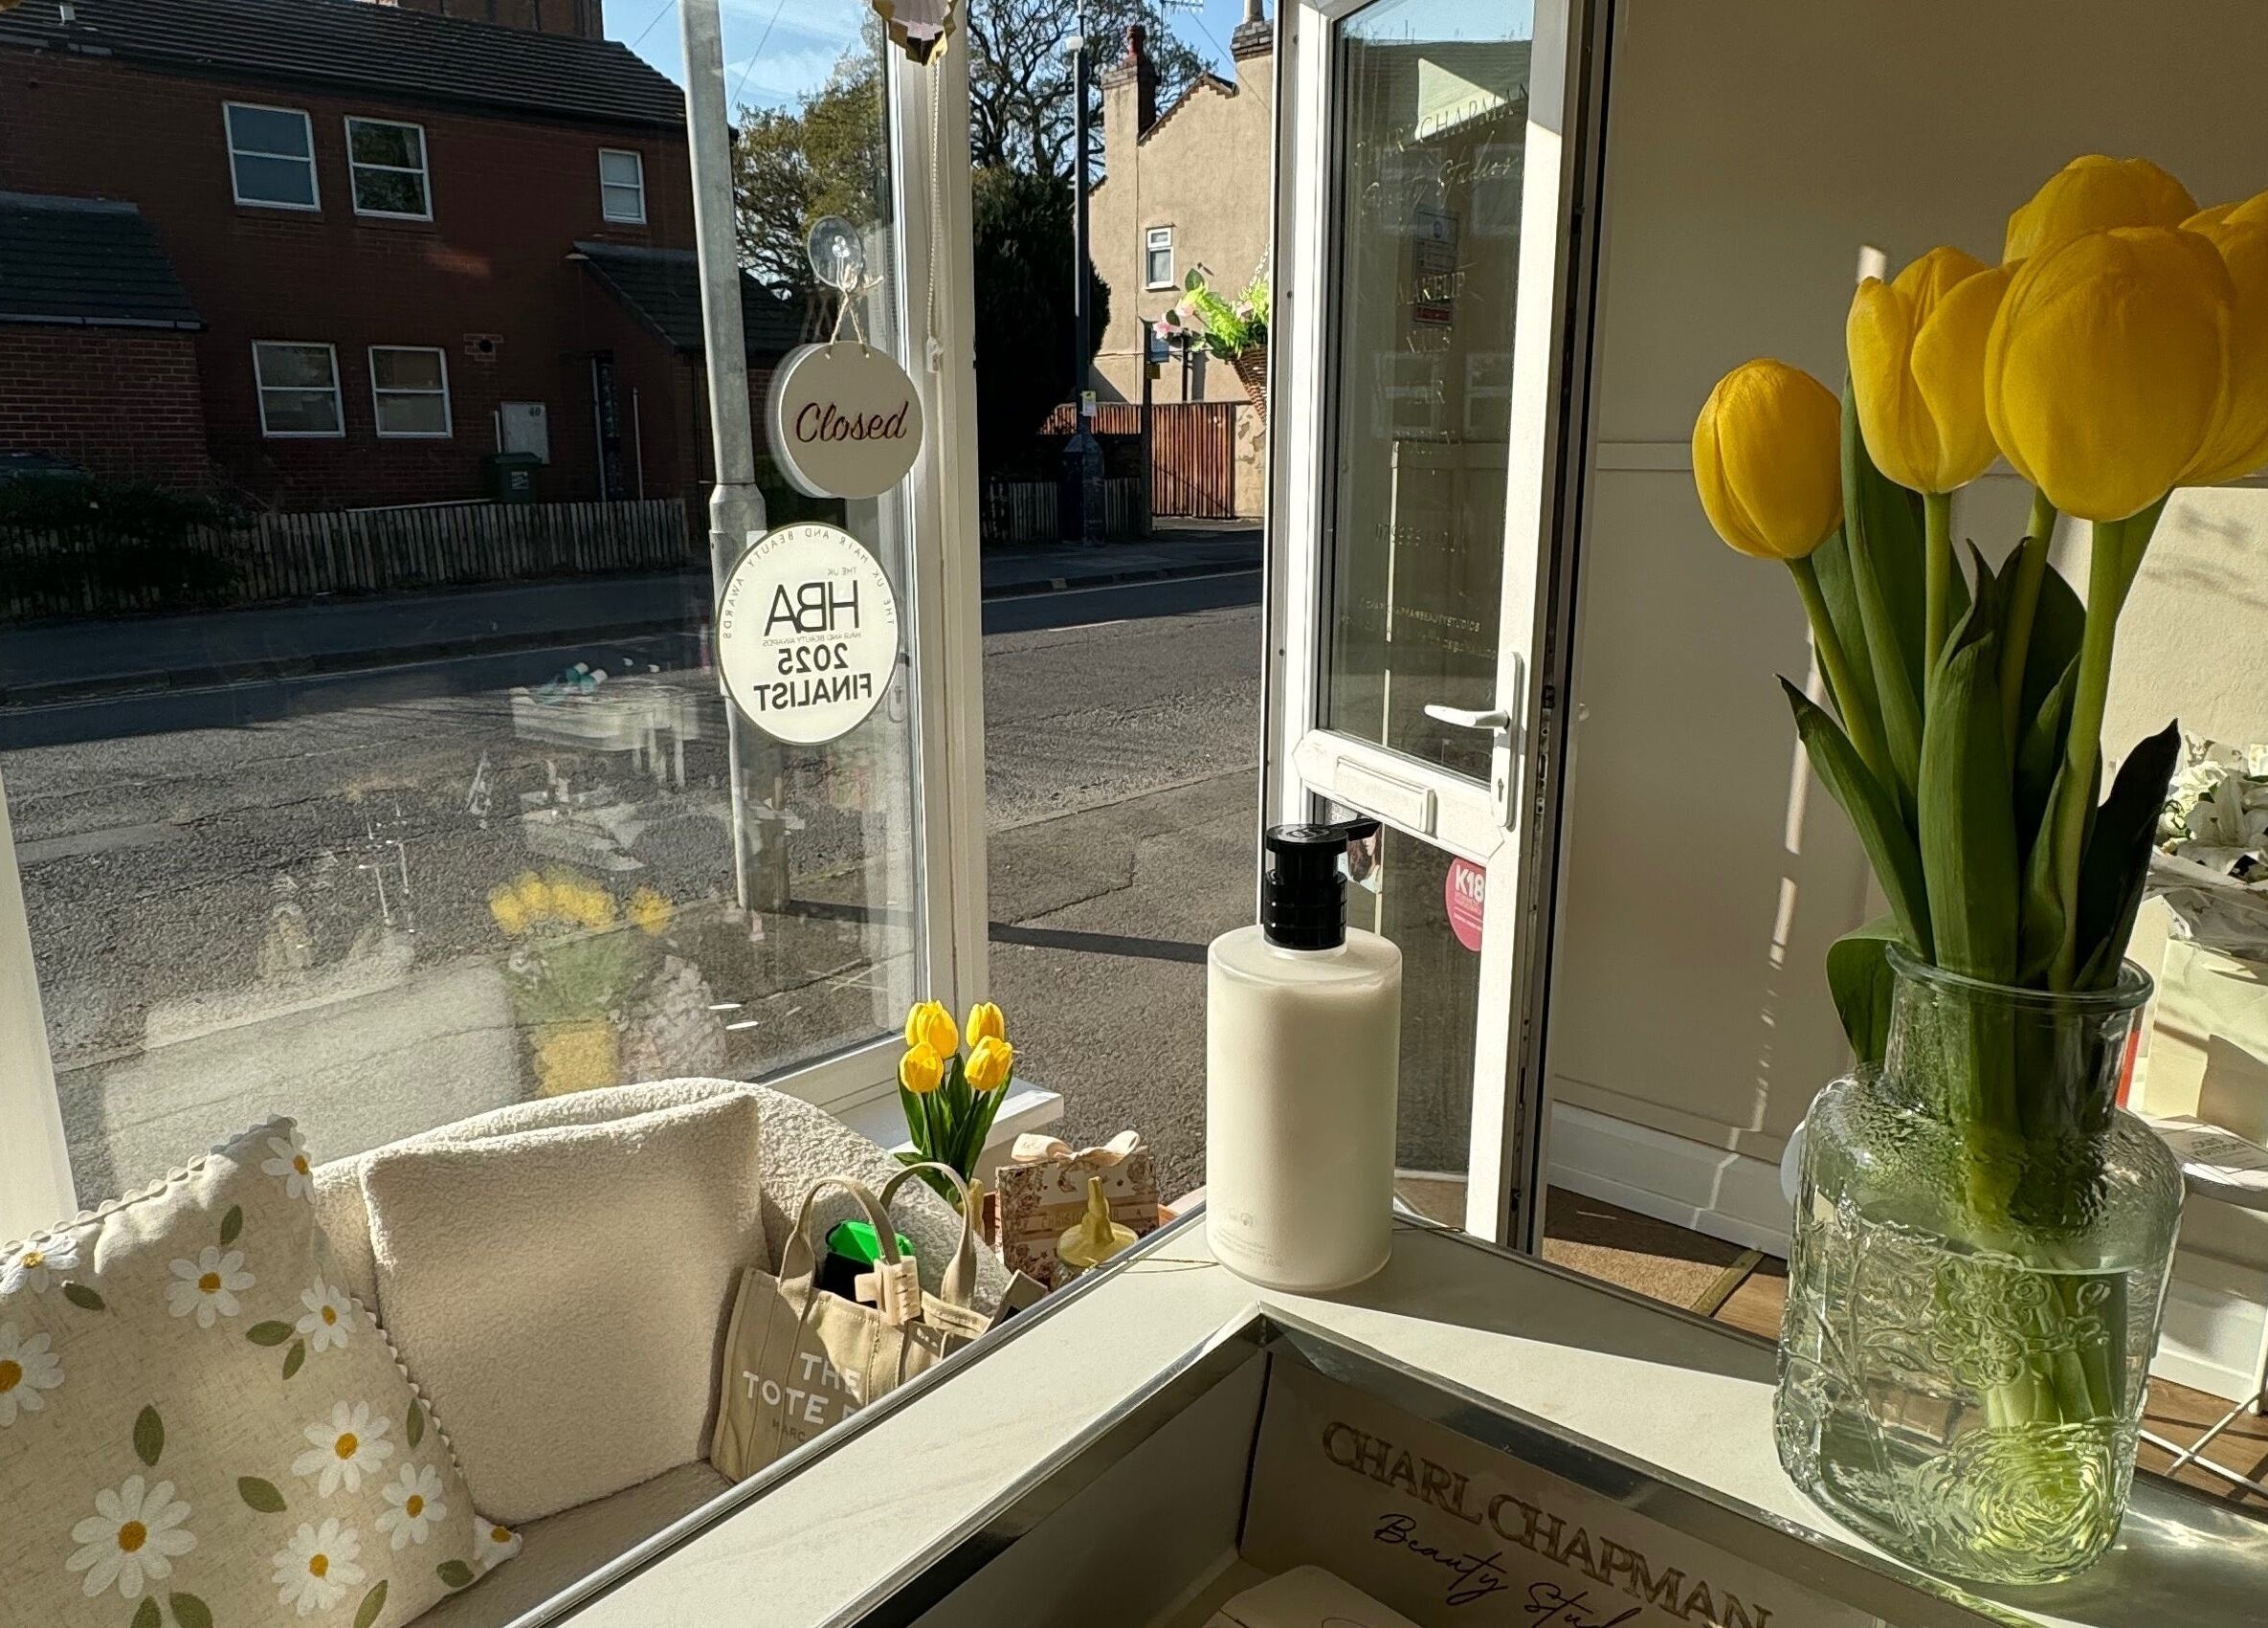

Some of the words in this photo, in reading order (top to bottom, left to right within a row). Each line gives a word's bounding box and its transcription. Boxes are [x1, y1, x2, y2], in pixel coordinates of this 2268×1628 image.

[796, 399, 910, 443] Closed
[1455, 864, 1485, 903] K18
[800, 1351, 861, 1390] THE
[743, 1370, 829, 1425] TOTE
[1322, 1421, 1482, 1526] CHARL
[1487, 1494, 1773, 1628] CHAPMAN
[1373, 1513, 1509, 1606] Beauty
